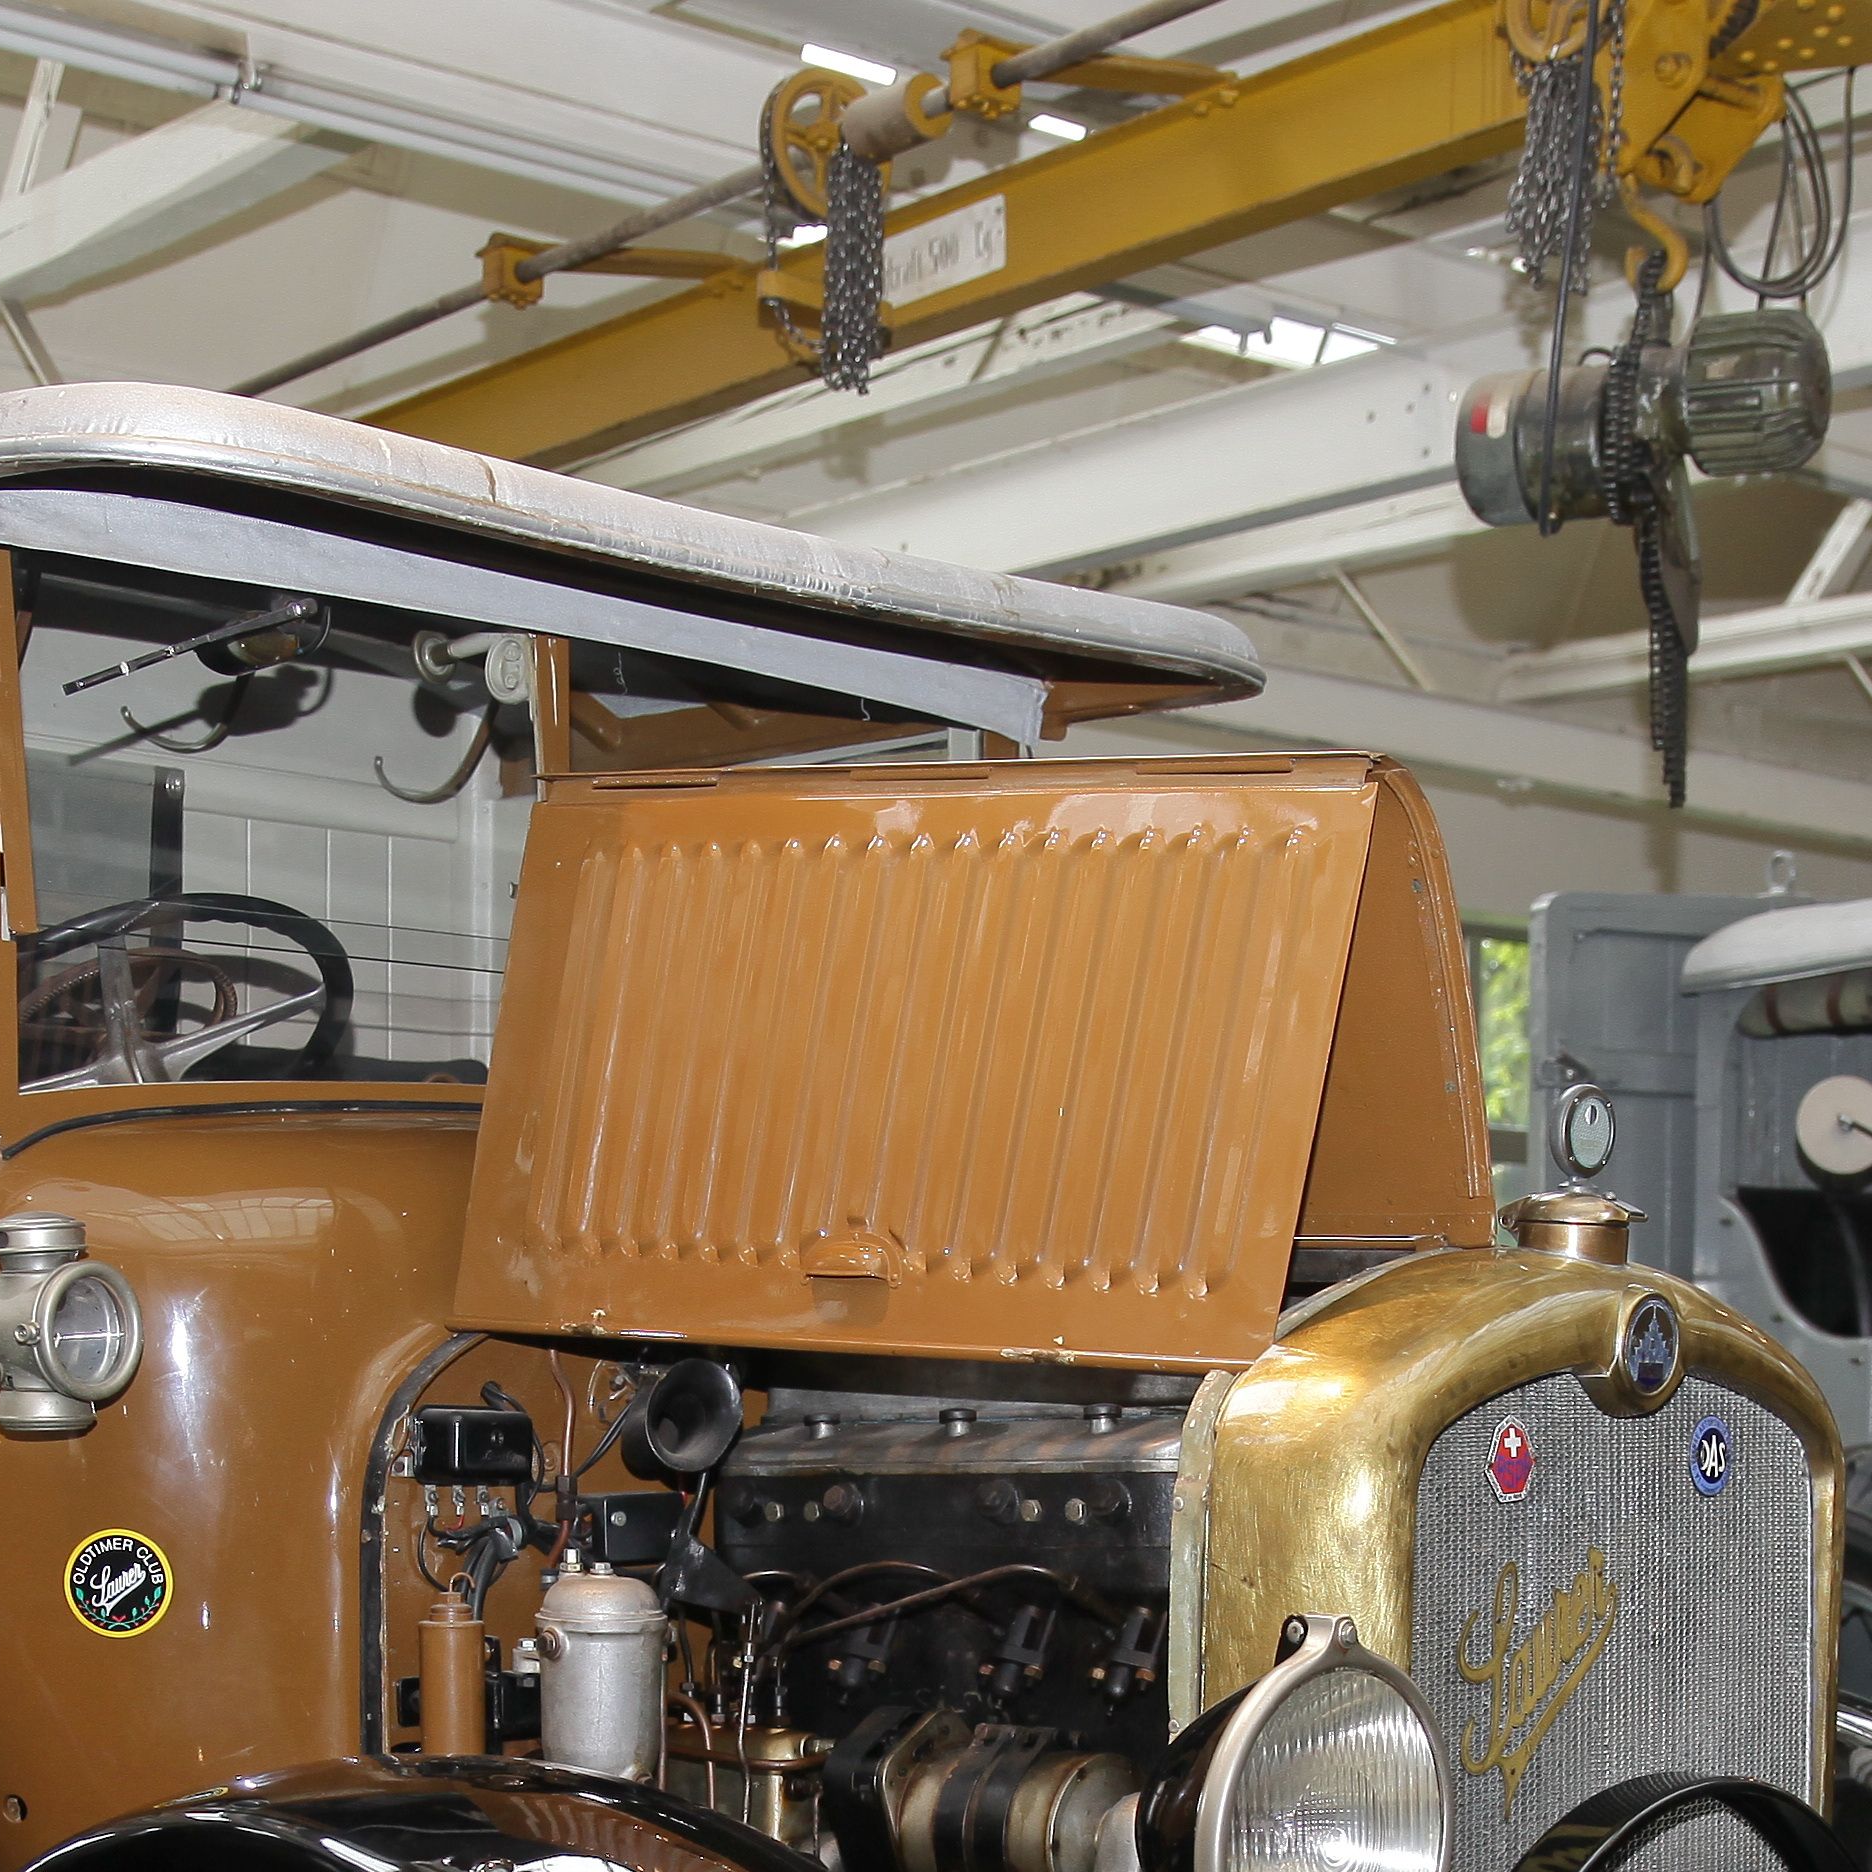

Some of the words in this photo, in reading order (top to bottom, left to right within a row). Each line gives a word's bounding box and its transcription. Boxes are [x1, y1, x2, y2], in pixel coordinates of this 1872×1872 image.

[1701, 1434, 1727, 1478] DAS
[72, 1537, 134, 1585] OLDTIMER
[136, 1546, 164, 1585] CLUB
[89, 1562, 146, 1617] Saurer
[1456, 1545, 1617, 1822] Saurer
